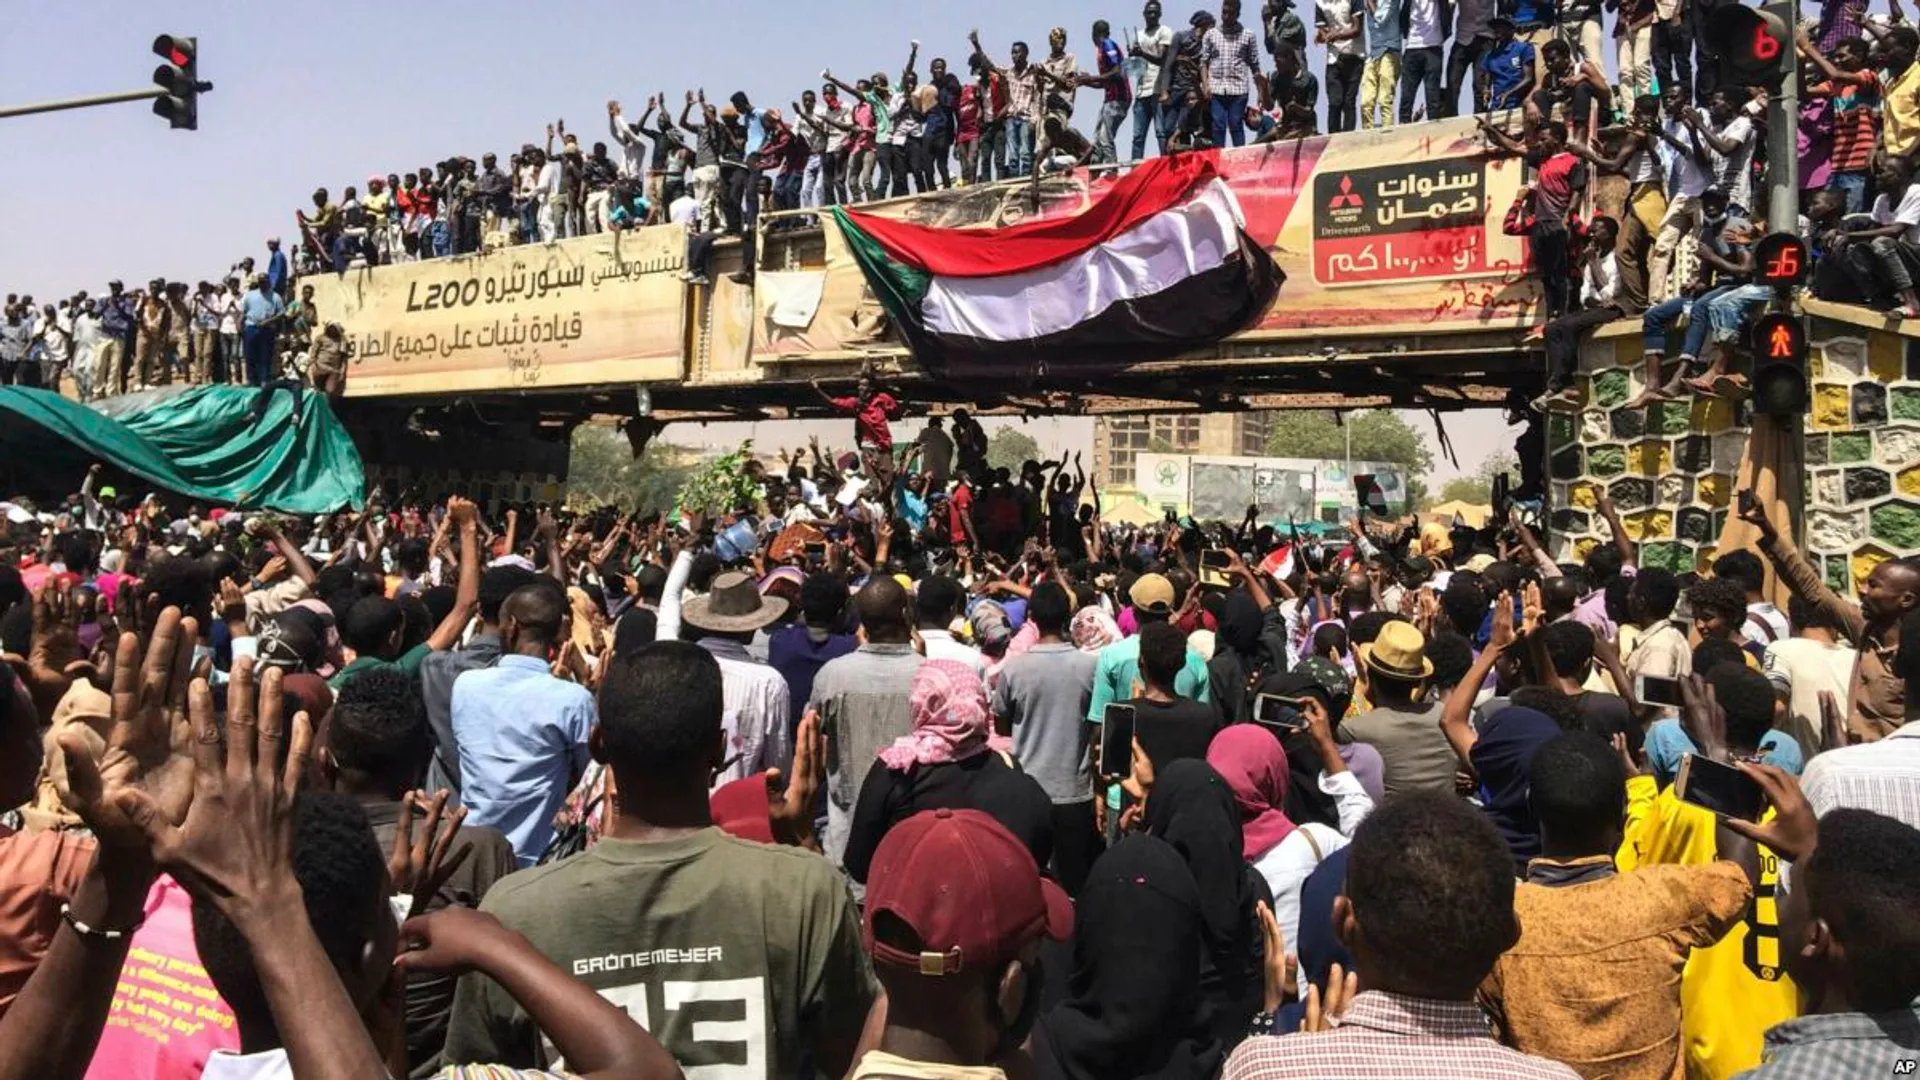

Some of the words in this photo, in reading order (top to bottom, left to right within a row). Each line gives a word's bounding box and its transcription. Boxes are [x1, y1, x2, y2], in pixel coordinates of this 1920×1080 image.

[1378, 170, 1478, 198] سنوات
[1377, 191, 1478, 225] ضمان
[1328, 243, 1378, 280] كم
[406, 278, 480, 313] L200
[393, 333, 437, 362] جميع
[440, 323, 472, 358] على
[477, 313, 527, 354] بثبات
[530, 311, 582, 349] قيادة
